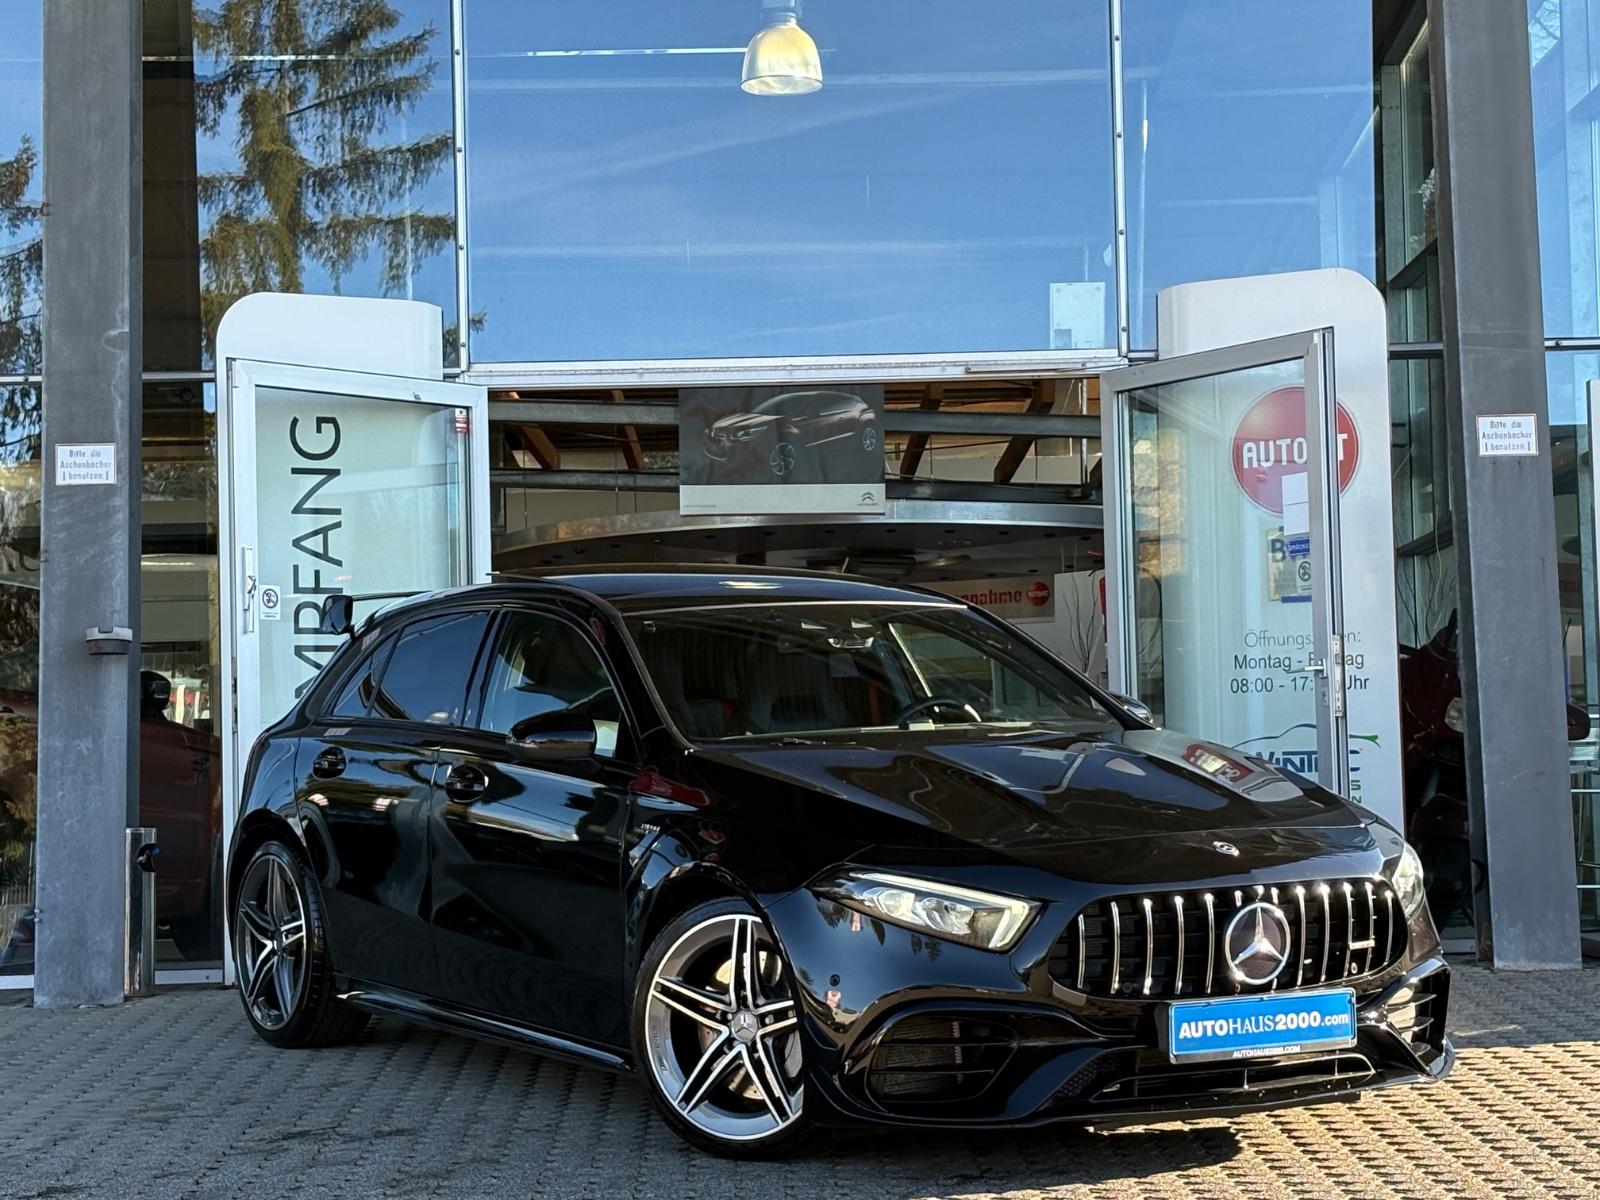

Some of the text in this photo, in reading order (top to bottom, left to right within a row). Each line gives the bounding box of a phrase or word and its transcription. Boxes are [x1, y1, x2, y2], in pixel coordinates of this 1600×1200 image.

[1490, 419, 1522, 429] Bitte die
[69, 448, 102, 458] Bitte die
[1242, 433, 1348, 469] AUTOT
[1234, 653, 1292, 671] Montag
[1230, 677, 1274, 694] 08:00
[1178, 1010, 1349, 1040] AUTOHAUS2000.com
